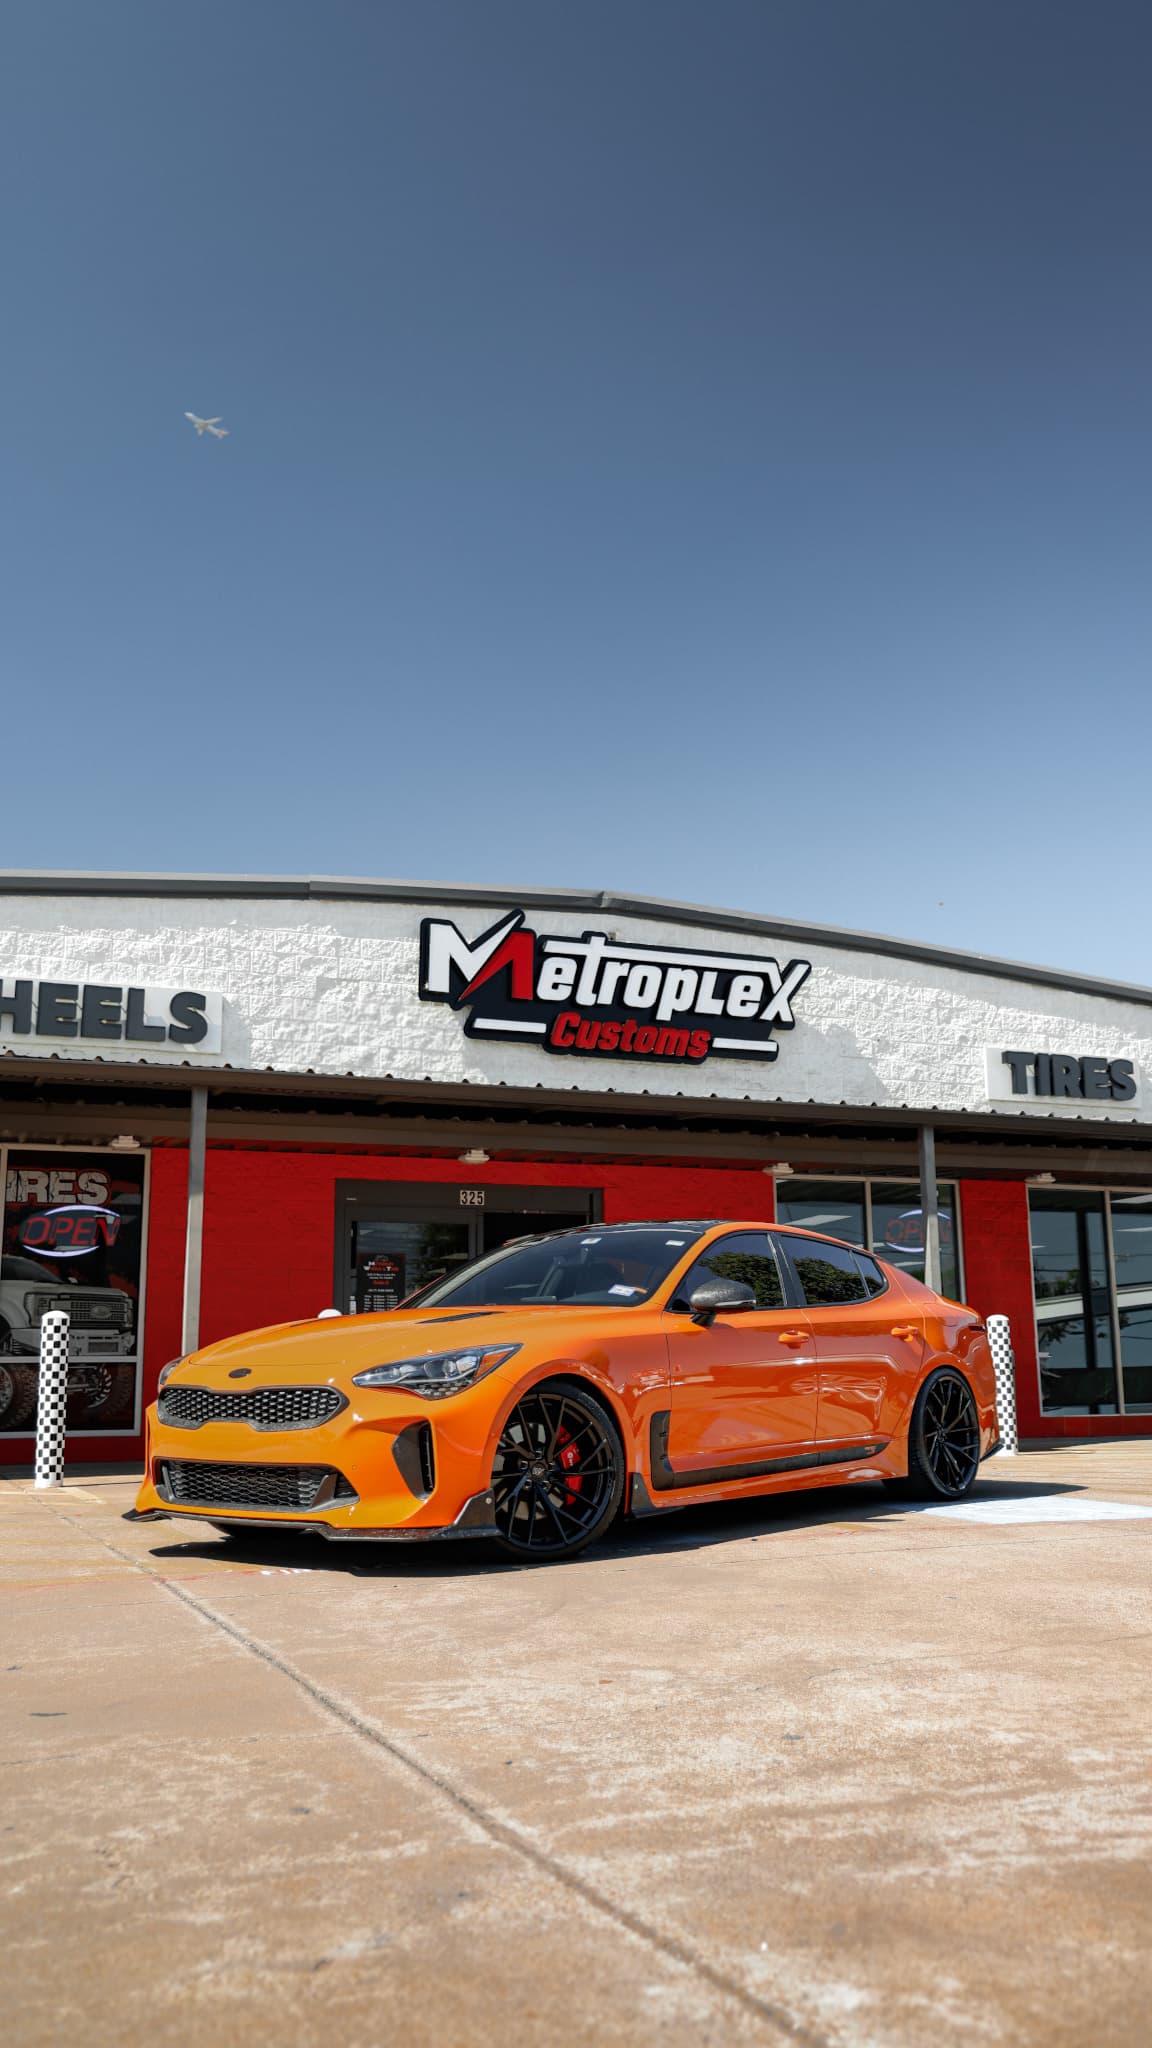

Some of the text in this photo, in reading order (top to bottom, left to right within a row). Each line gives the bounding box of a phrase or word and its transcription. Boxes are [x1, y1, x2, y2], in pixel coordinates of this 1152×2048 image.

[550, 1011, 711, 1058] Customs
[1002, 1051, 1137, 1101] TIRES
[461, 1191, 483, 1205] 325
[22, 1216, 121, 1246] OPEN
